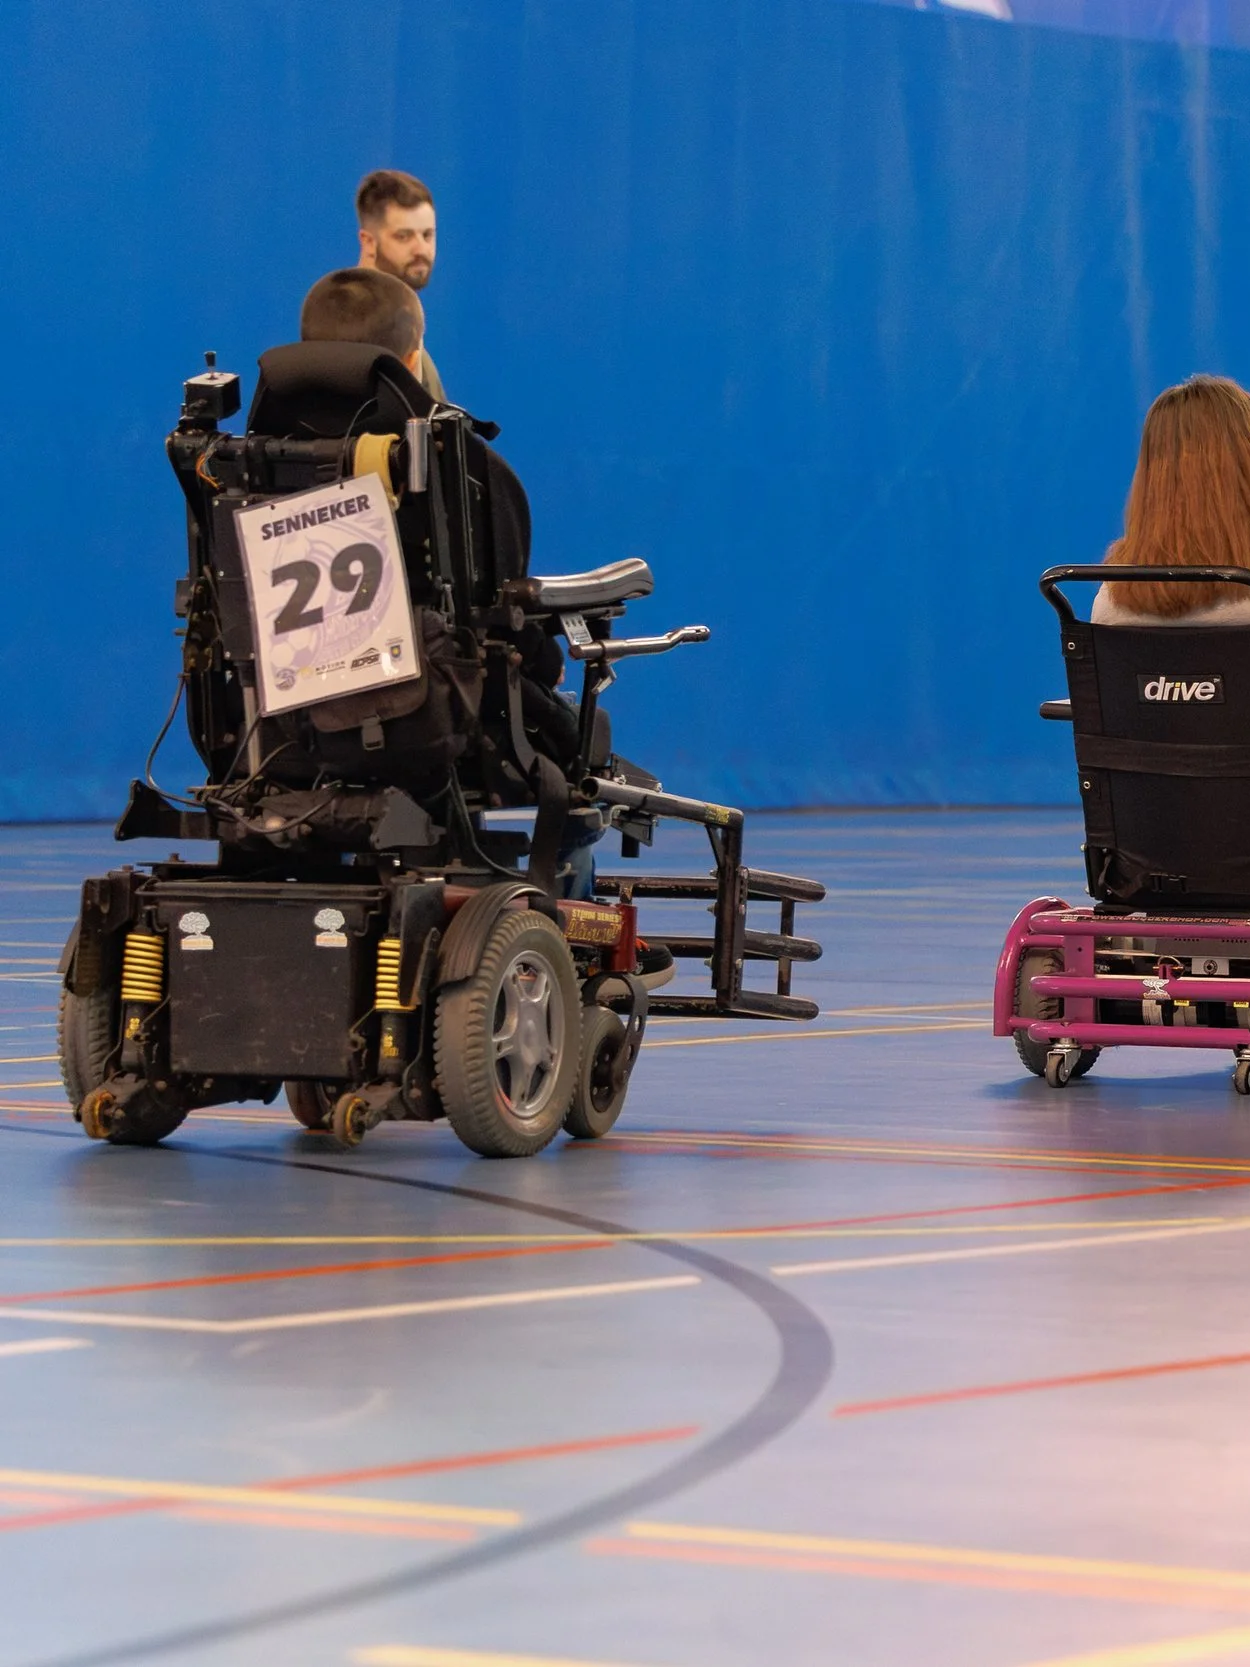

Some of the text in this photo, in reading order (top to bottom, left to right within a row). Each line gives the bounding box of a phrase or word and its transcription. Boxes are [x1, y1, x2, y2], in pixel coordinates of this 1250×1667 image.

[261, 494, 371, 540] SENNEKER
[271, 542, 384, 636] 29
[1144, 676, 1216, 701] drive
[1084, 914, 1230, 924] OWERSOCCERSHOP.COM
